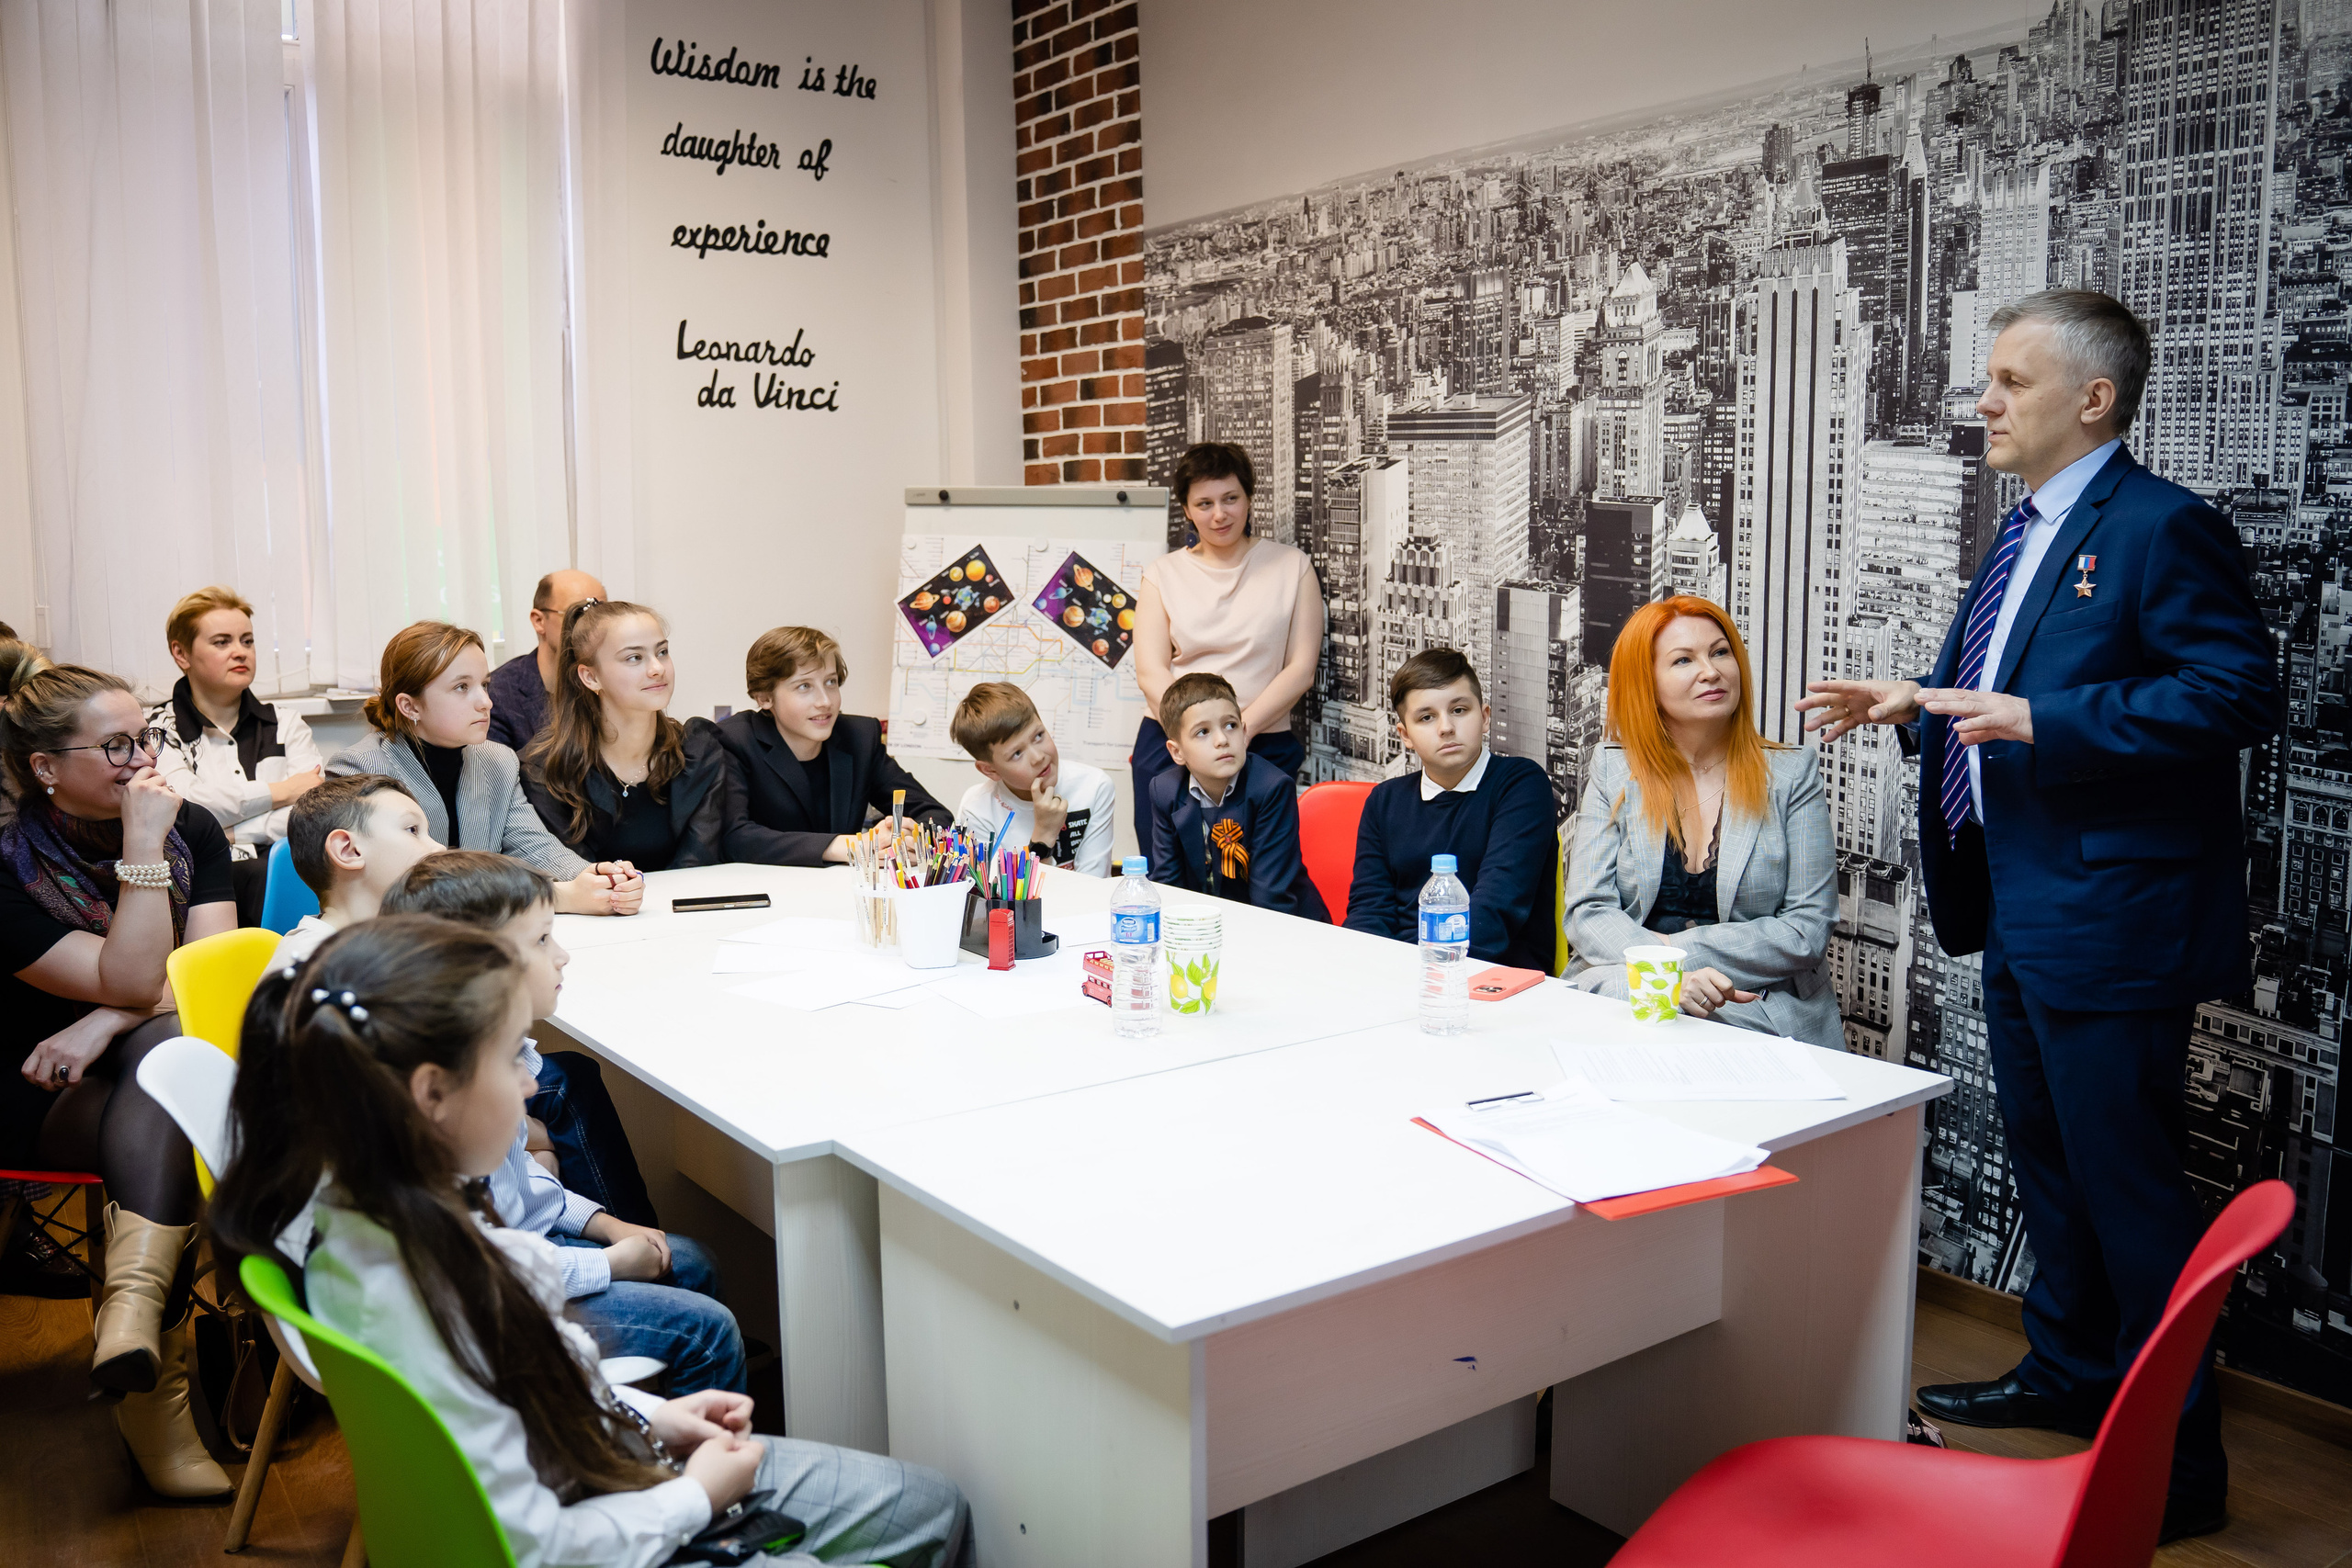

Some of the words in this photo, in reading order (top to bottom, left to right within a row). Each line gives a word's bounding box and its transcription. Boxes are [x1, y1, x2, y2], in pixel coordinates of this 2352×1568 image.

[650, 36, 781, 90] Wisdom
[797, 55, 826, 93] is
[831, 63, 878, 100] the
[660, 121, 781, 176] daughter
[797, 138, 833, 182] of
[670, 219, 831, 260] experience
[676, 319, 816, 368] Leonardo
[697, 368, 737, 409] da
[753, 372, 840, 412] Vinci
[1068, 818, 1088, 829] SKATE
[1069, 830, 1082, 839] ALL
